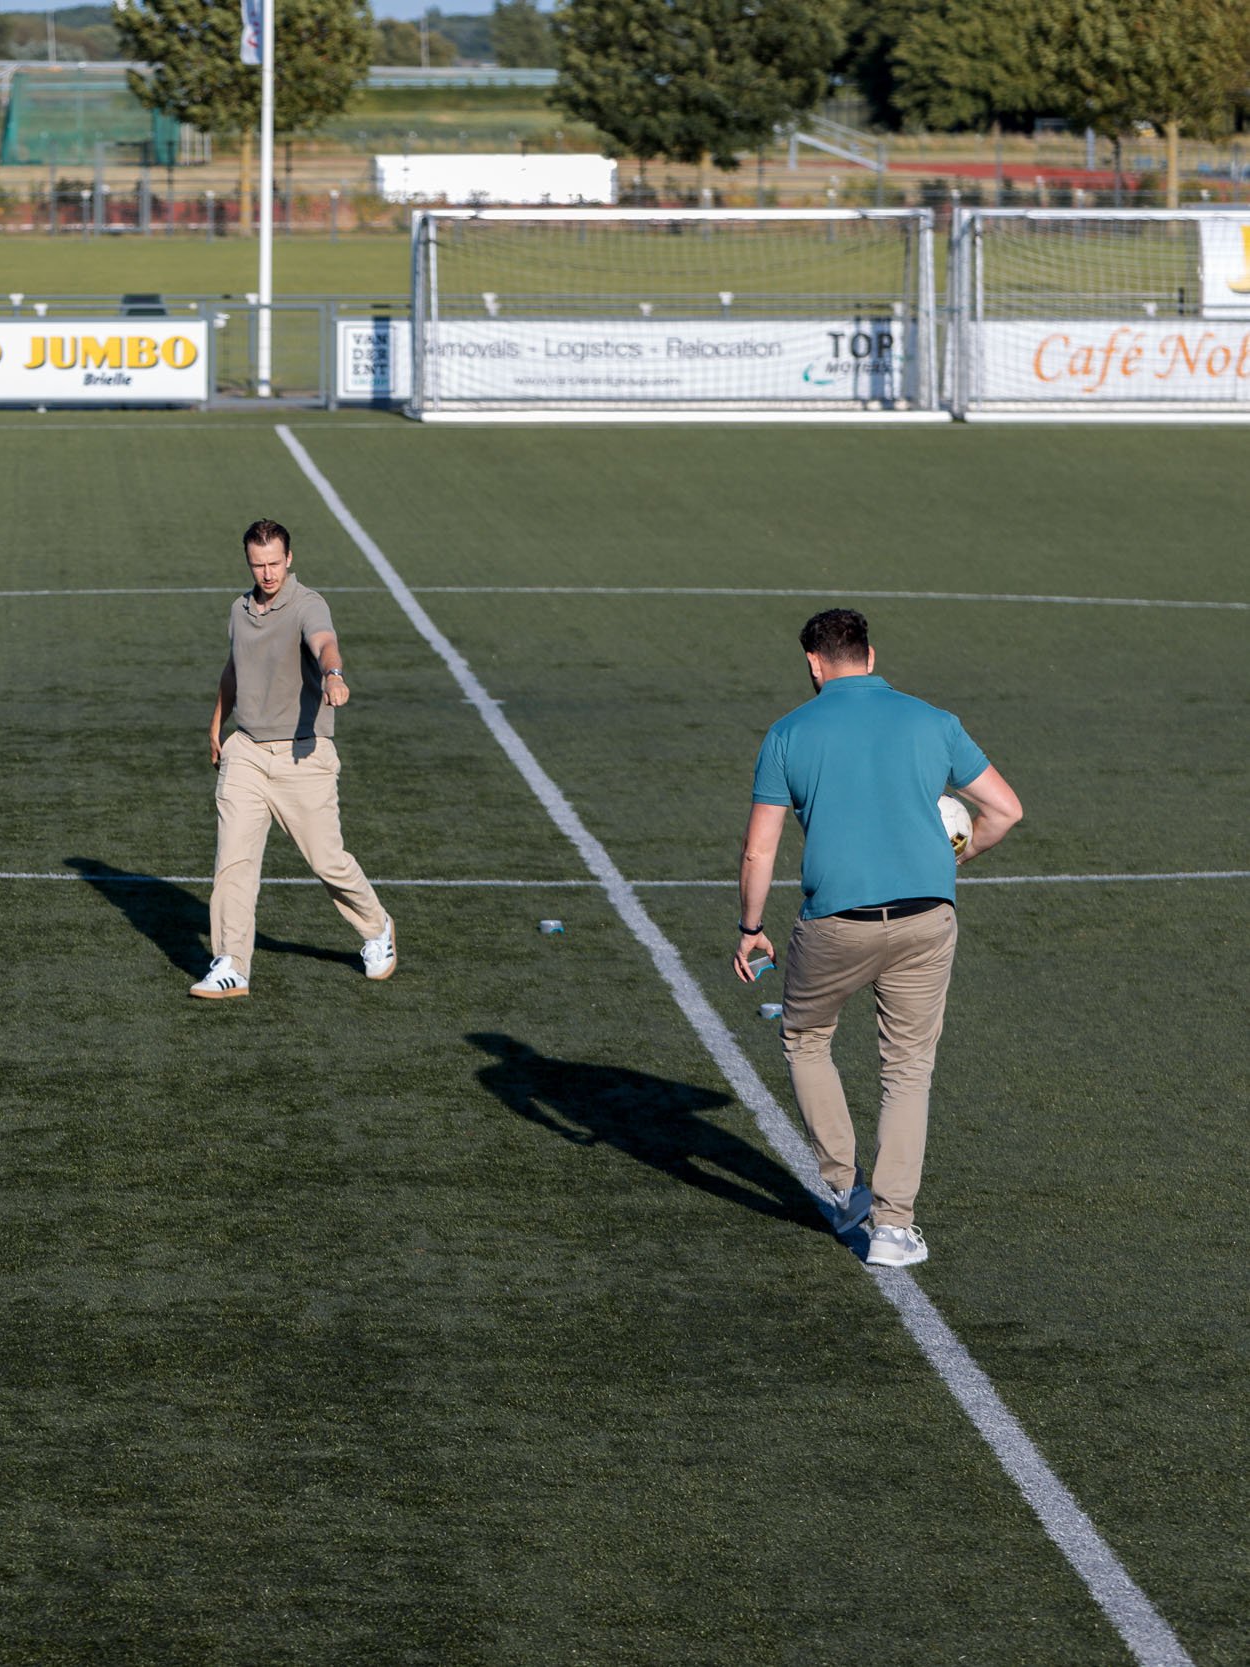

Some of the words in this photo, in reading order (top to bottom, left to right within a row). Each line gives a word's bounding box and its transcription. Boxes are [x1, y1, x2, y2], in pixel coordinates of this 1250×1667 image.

[352, 333, 388, 345] VAN
[423, 338, 520, 359] movals
[544, 337, 643, 363] Logistics
[666, 337, 783, 359] Relocation
[827, 333, 894, 358] TOP
[23, 335, 198, 370] JUMBO
[1033, 327, 1146, 393] Café
[83, 374, 131, 387] Brielle
